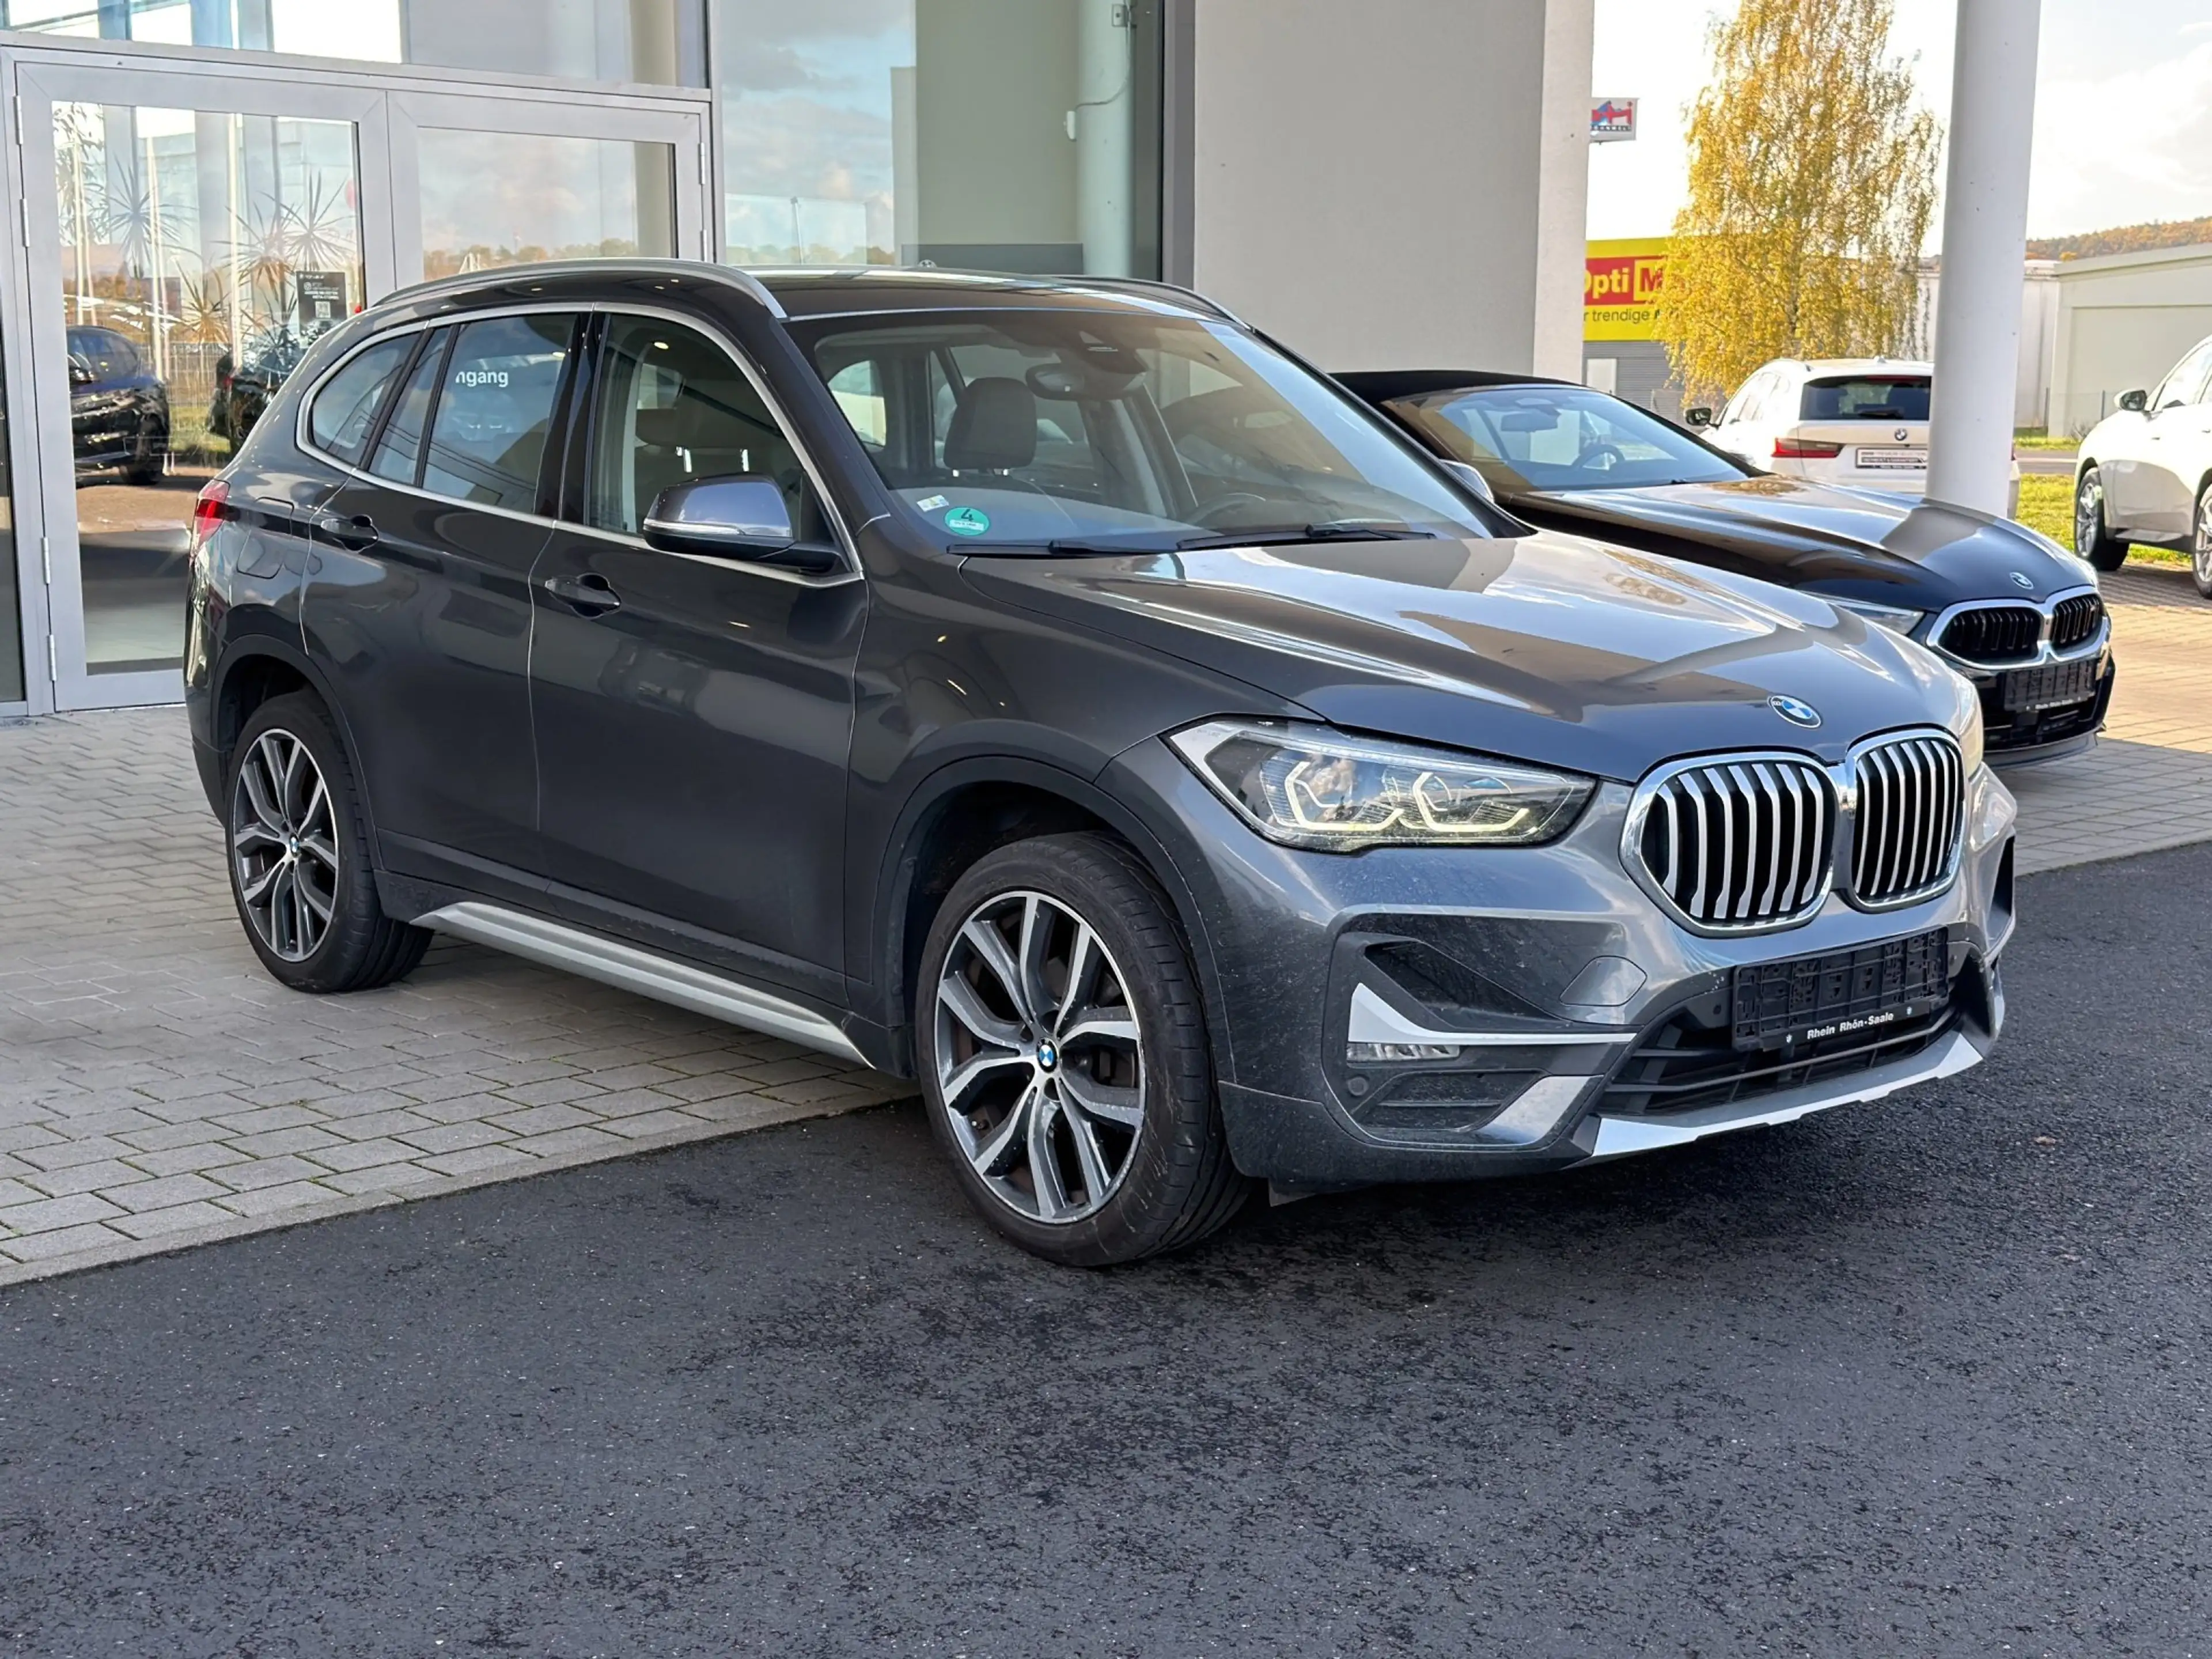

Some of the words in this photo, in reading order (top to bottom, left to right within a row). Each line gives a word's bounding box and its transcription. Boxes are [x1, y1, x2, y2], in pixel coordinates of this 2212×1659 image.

[1592, 309, 1650, 324] trendige
[961, 508, 974, 521] 4
[1806, 1025, 1836, 1039] Rhein
